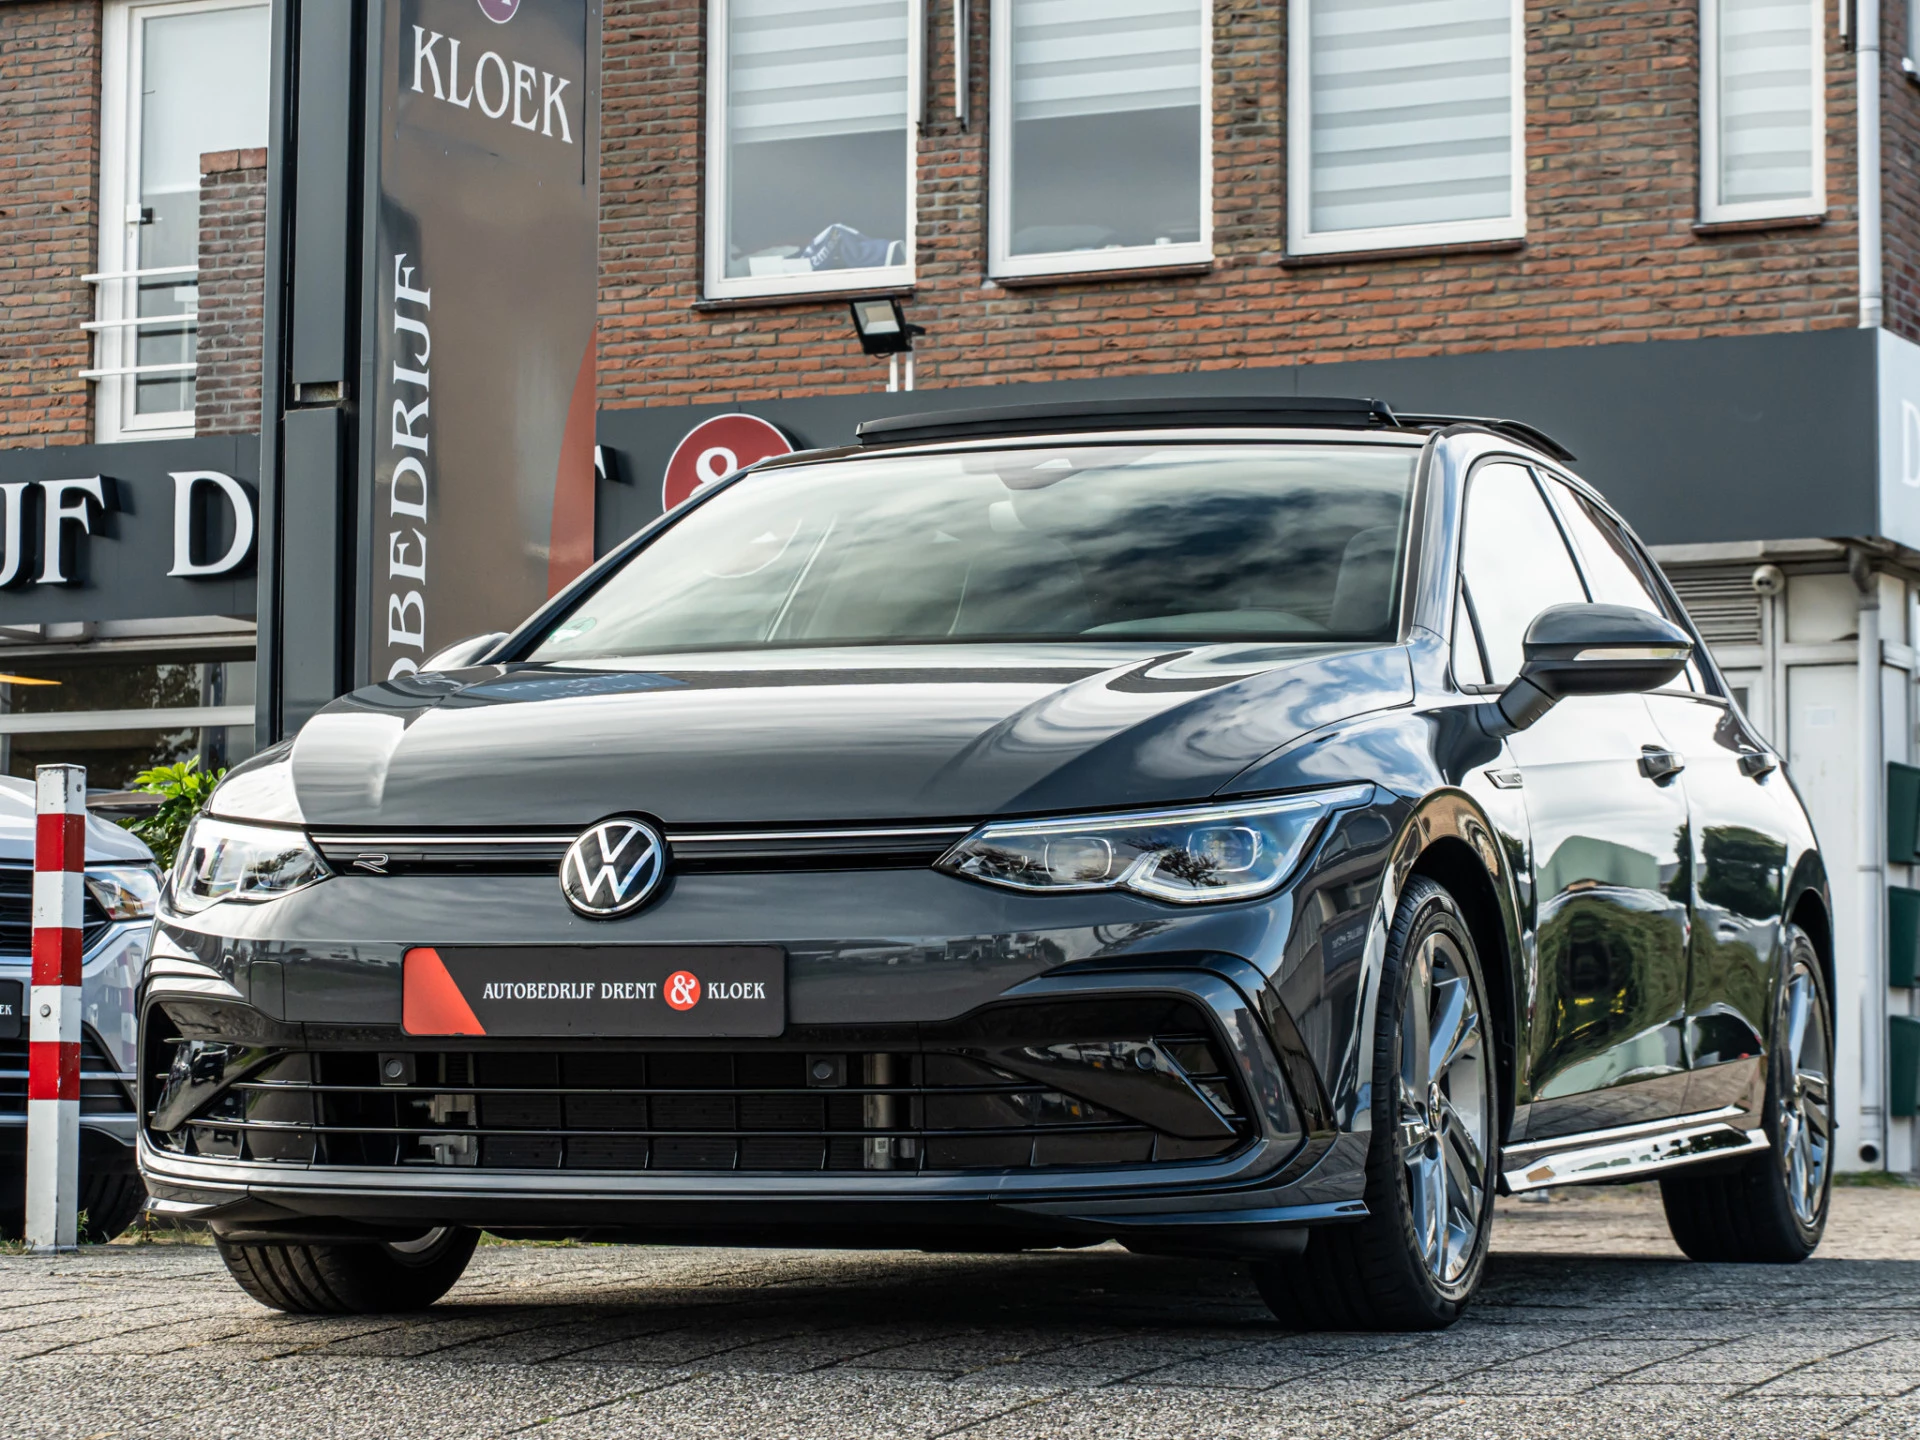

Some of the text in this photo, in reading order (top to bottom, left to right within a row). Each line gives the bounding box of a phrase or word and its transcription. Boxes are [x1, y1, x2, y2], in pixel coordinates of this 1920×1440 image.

[410, 24, 573, 144] KLOEK
[482, 974, 766, 1005] AUTOBEDRIJF DRENT & KLOEK
